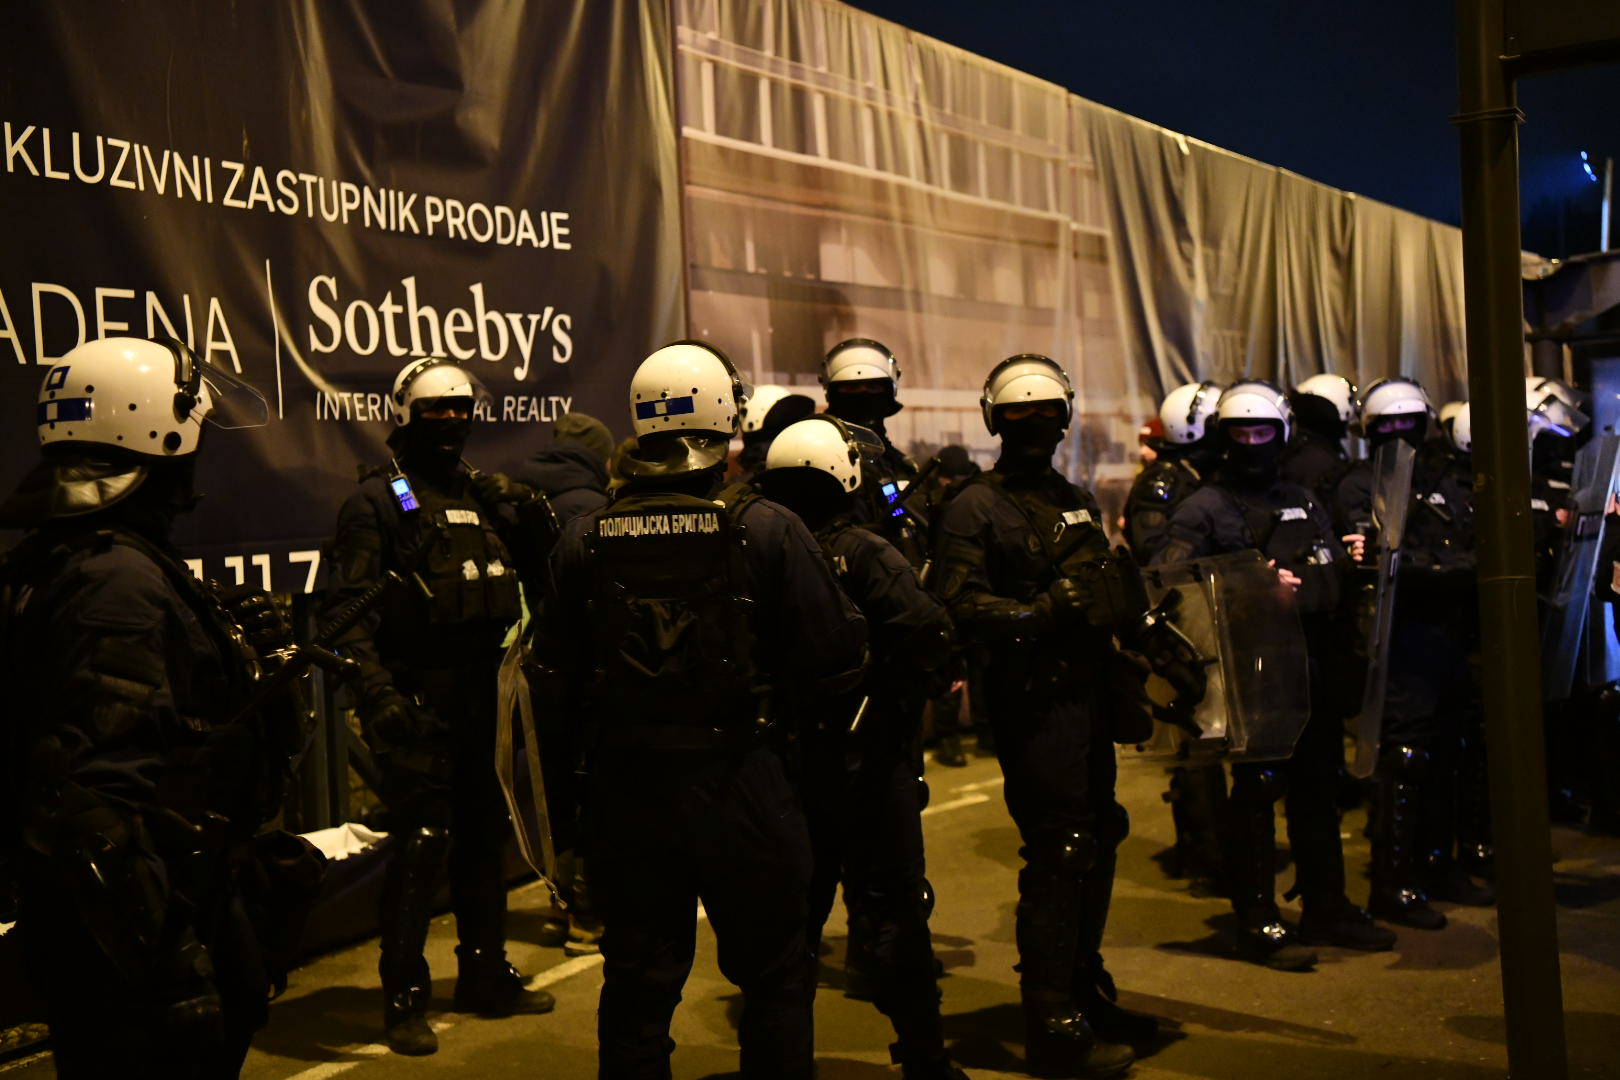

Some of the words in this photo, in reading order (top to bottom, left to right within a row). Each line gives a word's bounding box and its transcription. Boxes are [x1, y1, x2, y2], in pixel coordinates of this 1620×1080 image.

[4, 121, 213, 204] KLUZIVNI
[221, 160, 420, 234] ZASTUPNIK
[425, 195, 572, 250] PRODAJE
[308, 275, 573, 381] Sotheby's
[315, 391, 498, 422] INTERNAL
[503, 395, 572, 423] REALTY
[599, 515, 670, 538] ПОЛИЦИЈСКА
[671, 512, 720, 534] БРИГАДА
